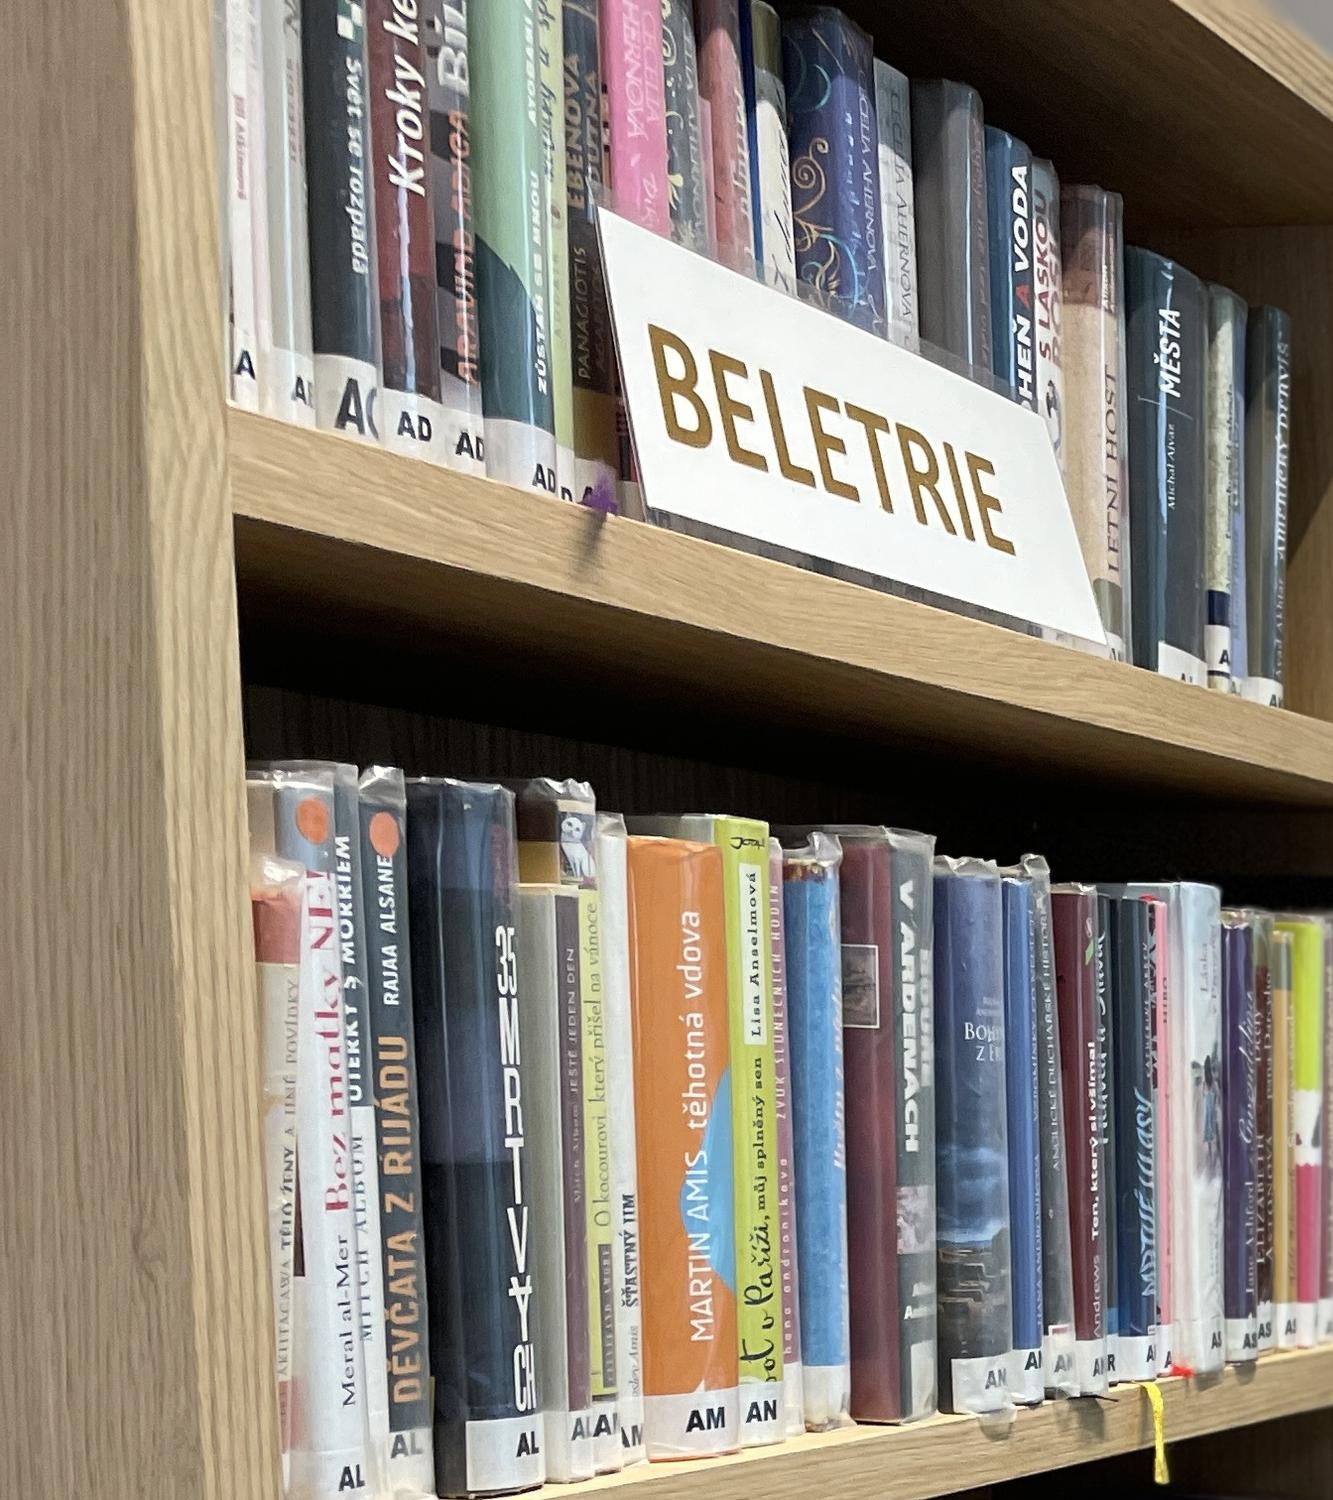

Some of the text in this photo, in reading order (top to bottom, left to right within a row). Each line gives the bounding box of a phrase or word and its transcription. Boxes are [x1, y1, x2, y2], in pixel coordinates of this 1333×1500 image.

[347, 125, 363, 159] se
[387, 54, 425, 198] Kroky
[1011, 165, 1030, 273] VODA
[1015, 283, 1032, 310] A
[1153, 308, 1181, 398] MĚSTA
[397, 410, 433, 442] AD
[1103, 362, 1119, 461] HOST
[648, 322, 1016, 556] BELETRIE
[532, 463, 557, 494] AD
[1167, 464, 1176, 510] Michal
[899, 879, 915, 910] V
[381, 945, 401, 1006] RAJAA
[565, 947, 576, 984] DEN
[745, 871, 764, 1037] Lisa Anselmová
[313, 964, 345, 1117] matky
[566, 989, 578, 1041] JEDEN
[581, 902, 612, 1228] O který přišel na vánoce
[1086, 1041, 1098, 1110] všímal
[675, 908, 716, 1344] MARTIN AMIS těhotná vdova
[1088, 1114, 1098, 1133] si
[324, 1133, 350, 1213] Bez
[1089, 1136, 1101, 1192] který
[373, 1035, 421, 1403] DĚVČATA Z RIJÁDU
[743, 1056, 776, 1330] v Paříži, můj splněný sen
[1091, 1195, 1101, 1241] Ten,
[334, 1234, 352, 1322] al-Mer
[781, 1306, 793, 1355] hana
[1257, 1321, 1272, 1339] AS
[337, 1331, 357, 1408] Meral
[685, 1406, 726, 1433] AM
[745, 1399, 777, 1424] AN
[390, 1431, 423, 1459] AL
[515, 1430, 540, 1458] AL
[338, 1463, 366, 1491] AL
